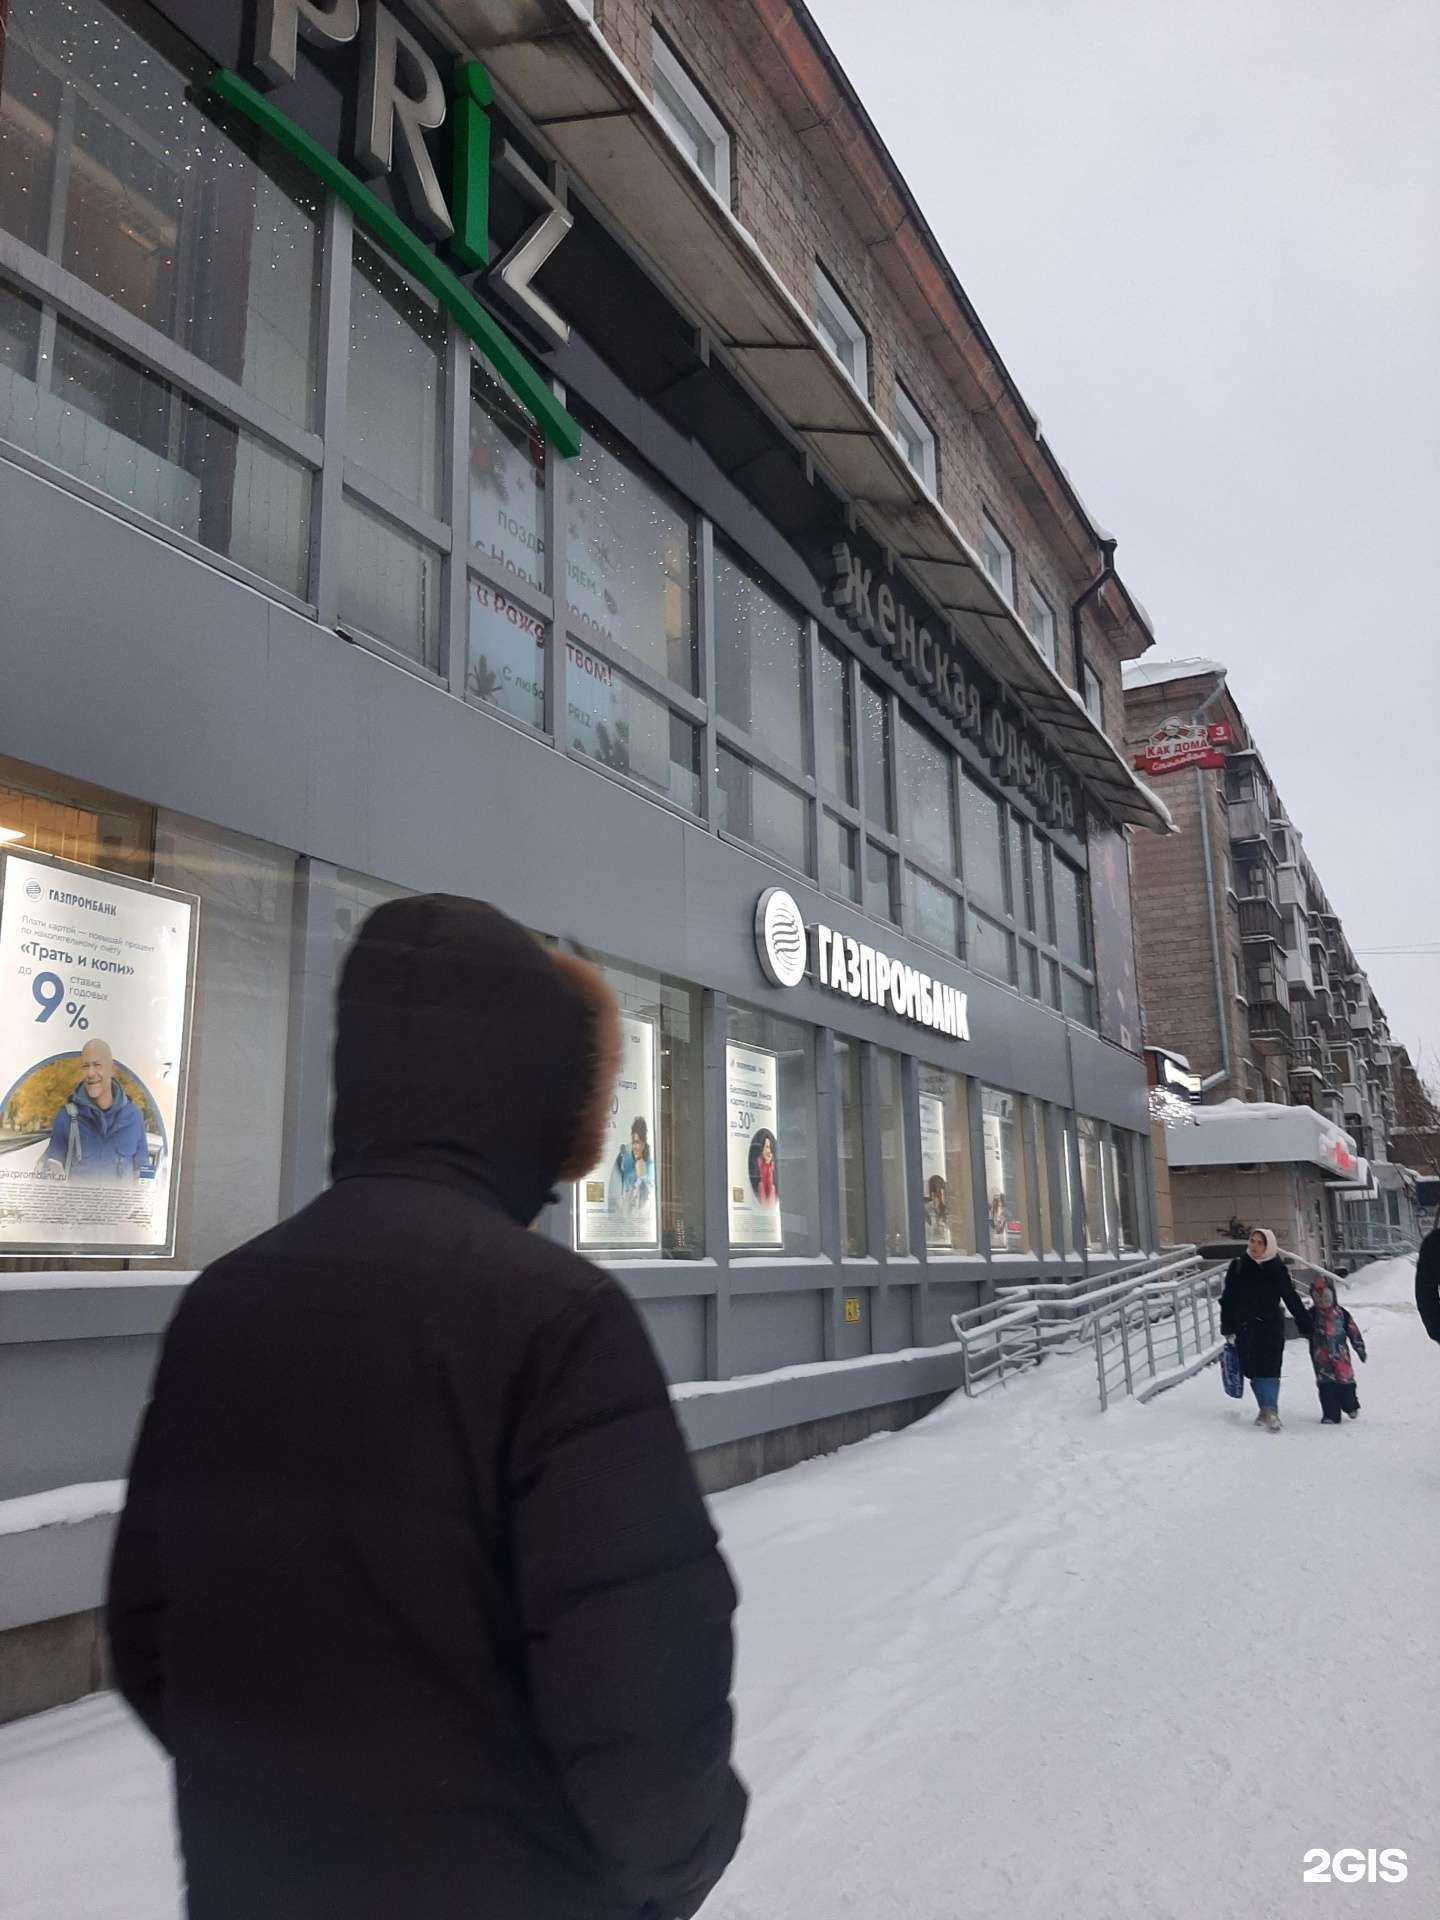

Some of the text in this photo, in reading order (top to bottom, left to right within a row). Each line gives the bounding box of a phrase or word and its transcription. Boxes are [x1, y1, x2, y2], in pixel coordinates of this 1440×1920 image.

[49, 888, 118, 917] ГАЗПРОМБАНК
[78, 955, 88, 967] и
[816, 924, 971, 1042] ГАЗПРОМБАНК
